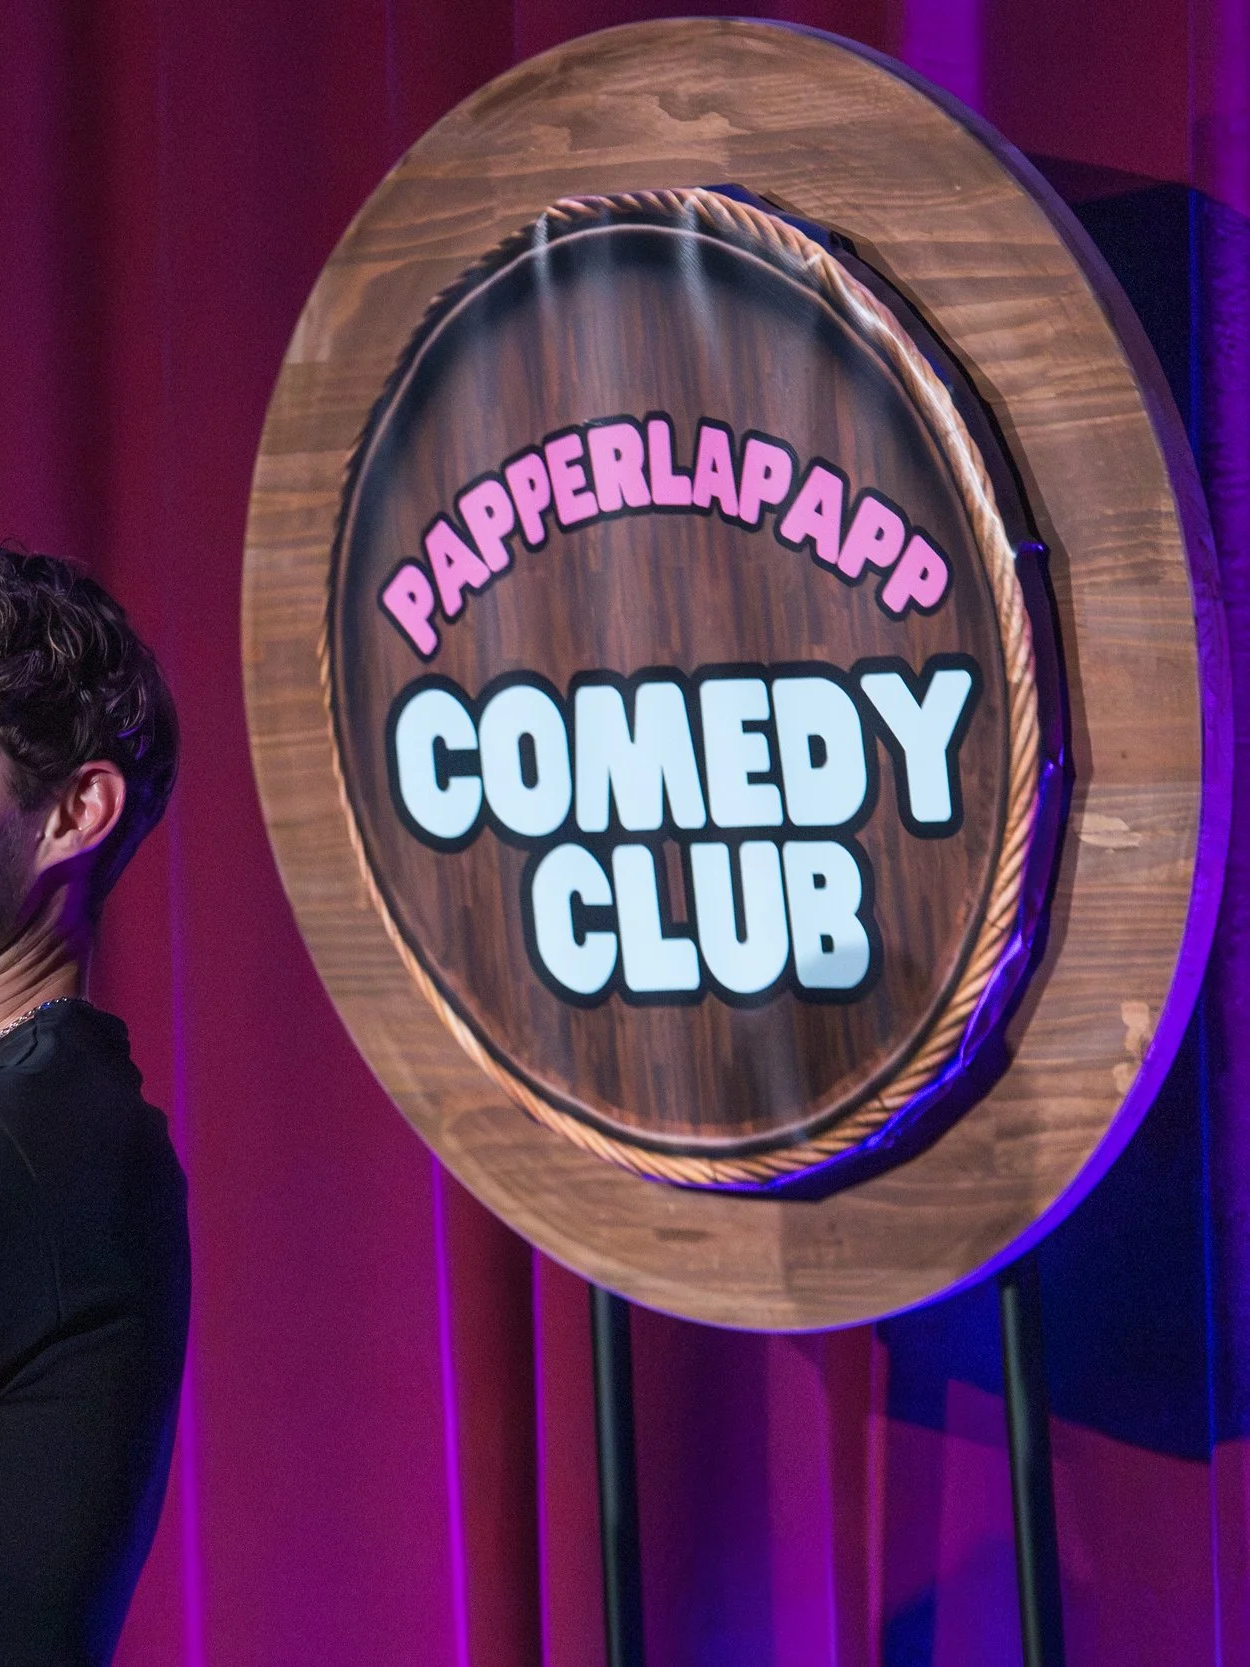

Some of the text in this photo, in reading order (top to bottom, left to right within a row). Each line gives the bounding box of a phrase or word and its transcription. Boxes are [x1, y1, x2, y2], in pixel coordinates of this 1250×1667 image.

[382, 419, 949, 656] PAPPERLAPAPP
[395, 669, 972, 839] COMEDY
[531, 840, 870, 995] CLUB
